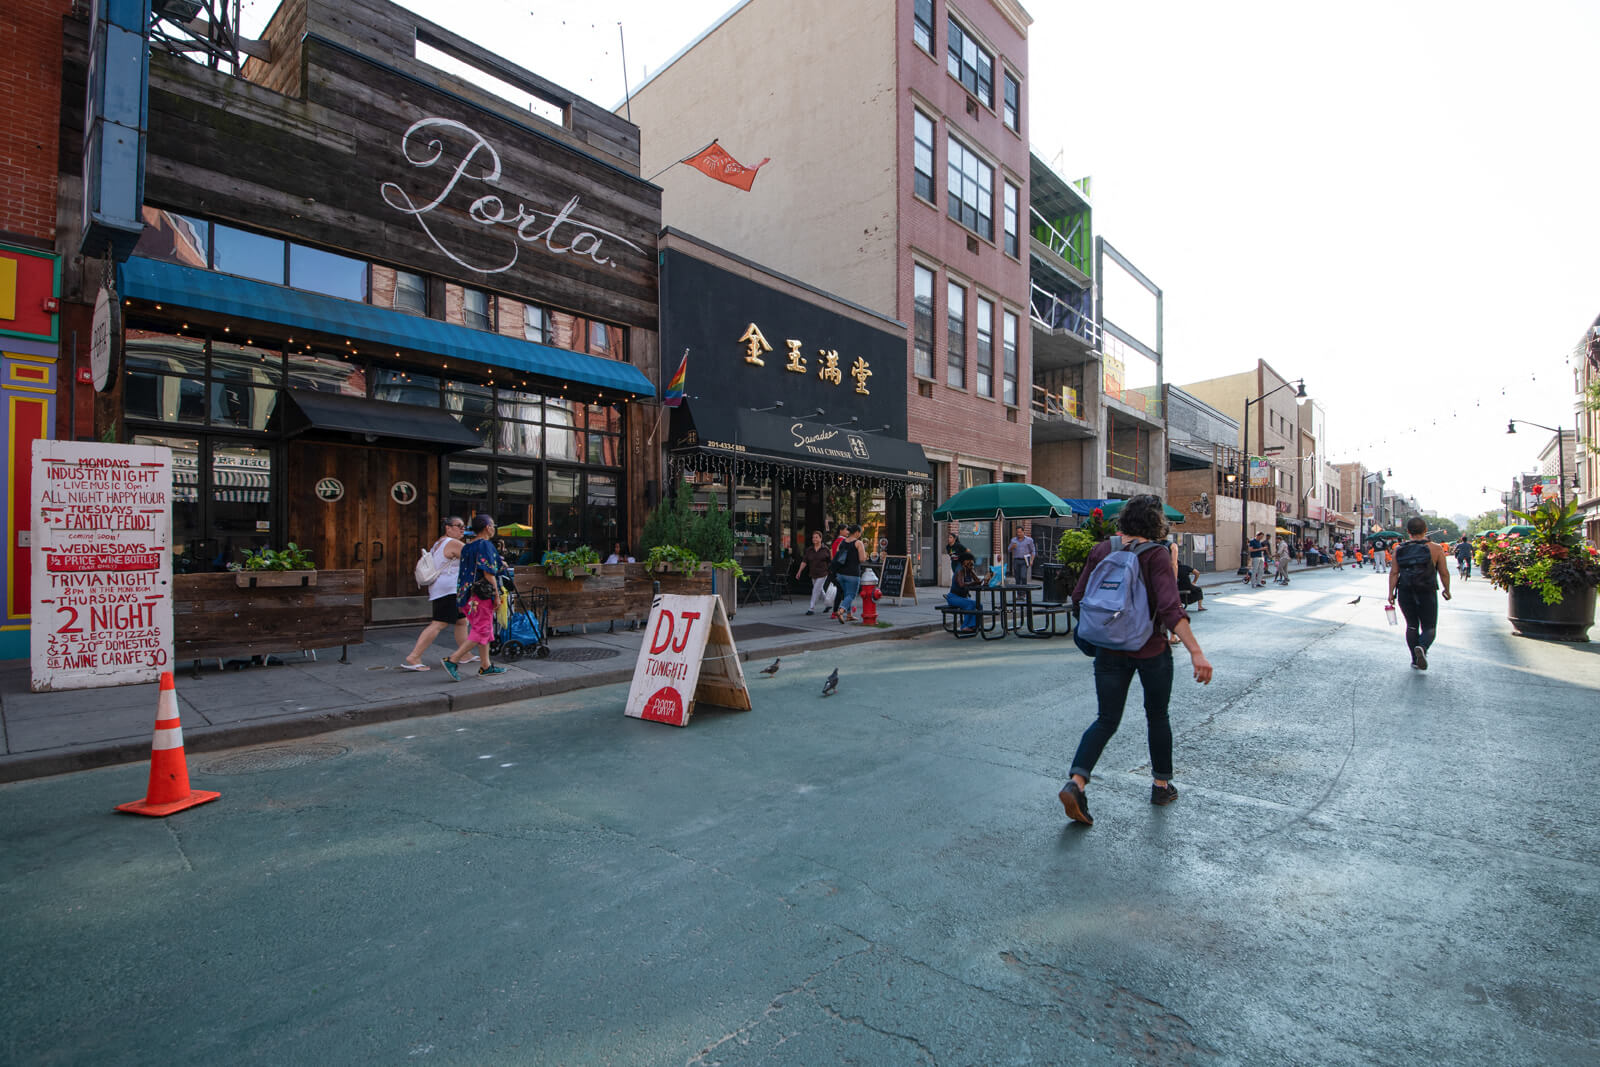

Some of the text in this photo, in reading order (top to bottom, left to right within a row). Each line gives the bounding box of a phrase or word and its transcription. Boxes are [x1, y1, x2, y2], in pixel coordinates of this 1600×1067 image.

[806, 445, 853, 459] THAI CHINESE
[78, 458, 130, 469] MONDAYS
[47, 467, 160, 482] INDUSTRY NIGHT
[63, 481, 89, 489] LIVE
[89, 482, 121, 490] MUSIC
[41, 490, 165, 505] ALL NIGHT HAPPY HOUR
[67, 505, 133, 515] TUESDAYS
[65, 513, 150, 530] FAMILY FEUD!
[59, 543, 147, 554] WEDNESDAYS
[64, 555, 97, 566] PRICE
[97, 555, 123, 565] WINE
[124, 553, 159, 565] BOTTLES
[46, 571, 160, 588] TRIVIA NIGHT
[56, 594, 138, 606] THURSDAYS
[56, 602, 157, 634] 2 NIGHT
[47, 627, 160, 645] 2 SELECT PIZZAS
[649, 609, 701, 655] DJ
[46, 645, 58, 656] &
[60, 643, 71, 655] 2
[105, 637, 160, 651] DOMESTICS
[101, 650, 143, 665] CARAFE
[645, 658, 688, 681] TONIGHT!
[651, 698, 676, 717] PORTA
